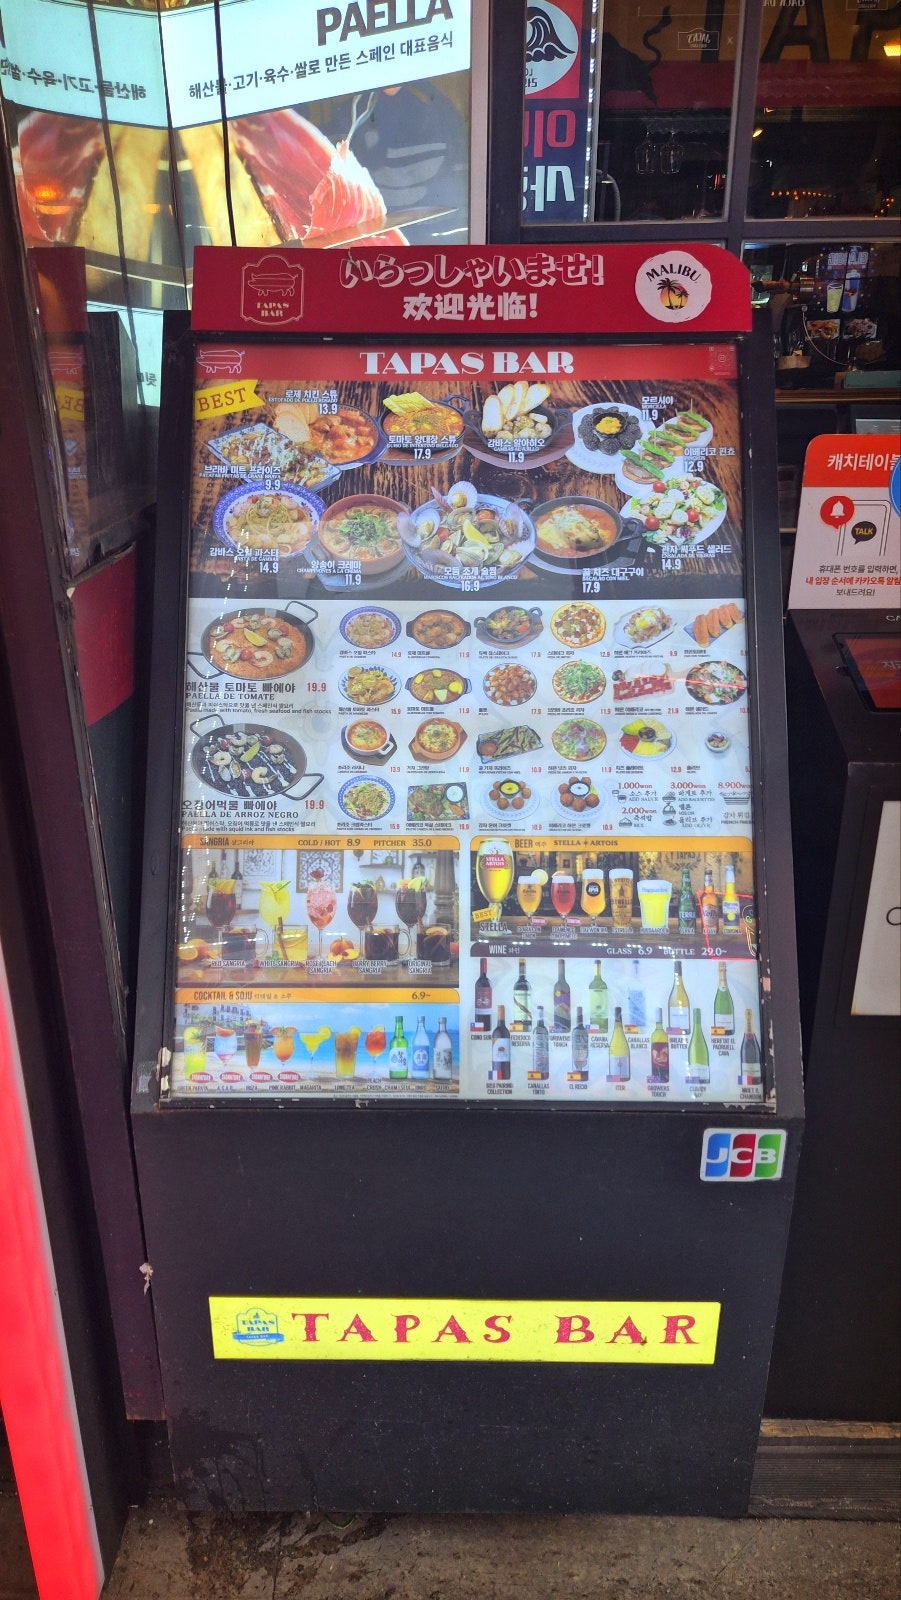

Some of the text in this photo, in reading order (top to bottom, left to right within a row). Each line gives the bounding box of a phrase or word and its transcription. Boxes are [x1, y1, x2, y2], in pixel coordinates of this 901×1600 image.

[325, 53, 351, 73] 만든
[356, 43, 395, 66] 스페인
[400, 31, 453, 57] 대표음식
[340, 252, 605, 288] いらっしゃいませ!
[256, 301, 290, 310] TAPAS
[402, 292, 538, 321] 欢迎光临!
[260, 310, 284, 318] BAR
[359, 351, 575, 375] TAPAS BAR
[197, 387, 247, 412] BEST
[285, 390, 302, 398] 로제
[304, 390, 319, 399] 치킨
[318, 404, 338, 415] 13.9
[641, 409, 659, 421] 11.9
[388, 435, 412, 444] 토마토
[487, 439, 512, 447] 감바스
[413, 449, 431, 460] 17.9
[684, 447, 716, 456] 이베리코
[508, 452, 525, 463] 11.9
[204, 465, 281, 474] 브라바 미트 프라이즈
[684, 461, 704, 472] 12.9
[265, 480, 281, 490] 9.9
[854, 527, 874, 535] TALK
[209, 547, 234, 557] 감바스
[259, 562, 279, 573] 14.9
[311, 560, 362, 569] 양송이 크레마
[661, 559, 682, 570] 14.9
[819, 565, 898, 574] 휴대폰 번호를 입력하면,
[463, 567, 479, 576] 조개
[611, 567, 644, 577] 대구구이
[345, 574, 362, 585] 11.9
[806, 576, 813, 585] 내
[815, 576, 829, 585] 입장
[832, 576, 853, 585] 순서에
[855, 576, 885, 585] 카카오톡
[460, 580, 480, 592] 16.9
[582, 582, 601, 593] 17.9
[836, 588, 875, 596] 보내드려요!
[186, 682, 296, 693] 해산물 토마토 빠에야
[306, 682, 327, 692] 19.9
[238, 693, 275, 701] TOMATE
[243, 800, 278, 811] 빠에야
[304, 800, 325, 810] 19.9
[268, 811, 299, 819] NEGRO
[200, 838, 229, 846] SANGRIA
[347, 839, 361, 847] 8.9
[412, 839, 432, 847] 35.0
[515, 839, 533, 848] BEER
[480, 922, 507, 932] STELLA
[489, 945, 507, 954] WINE
[606, 947, 632, 955] GLASS
[638, 946, 652, 954] 6.9
[194, 991, 252, 1000] COCKTAIL & SOJU
[706, 1147, 777, 1164] JCB
[291, 1312, 700, 1345] TAPAS BAR
